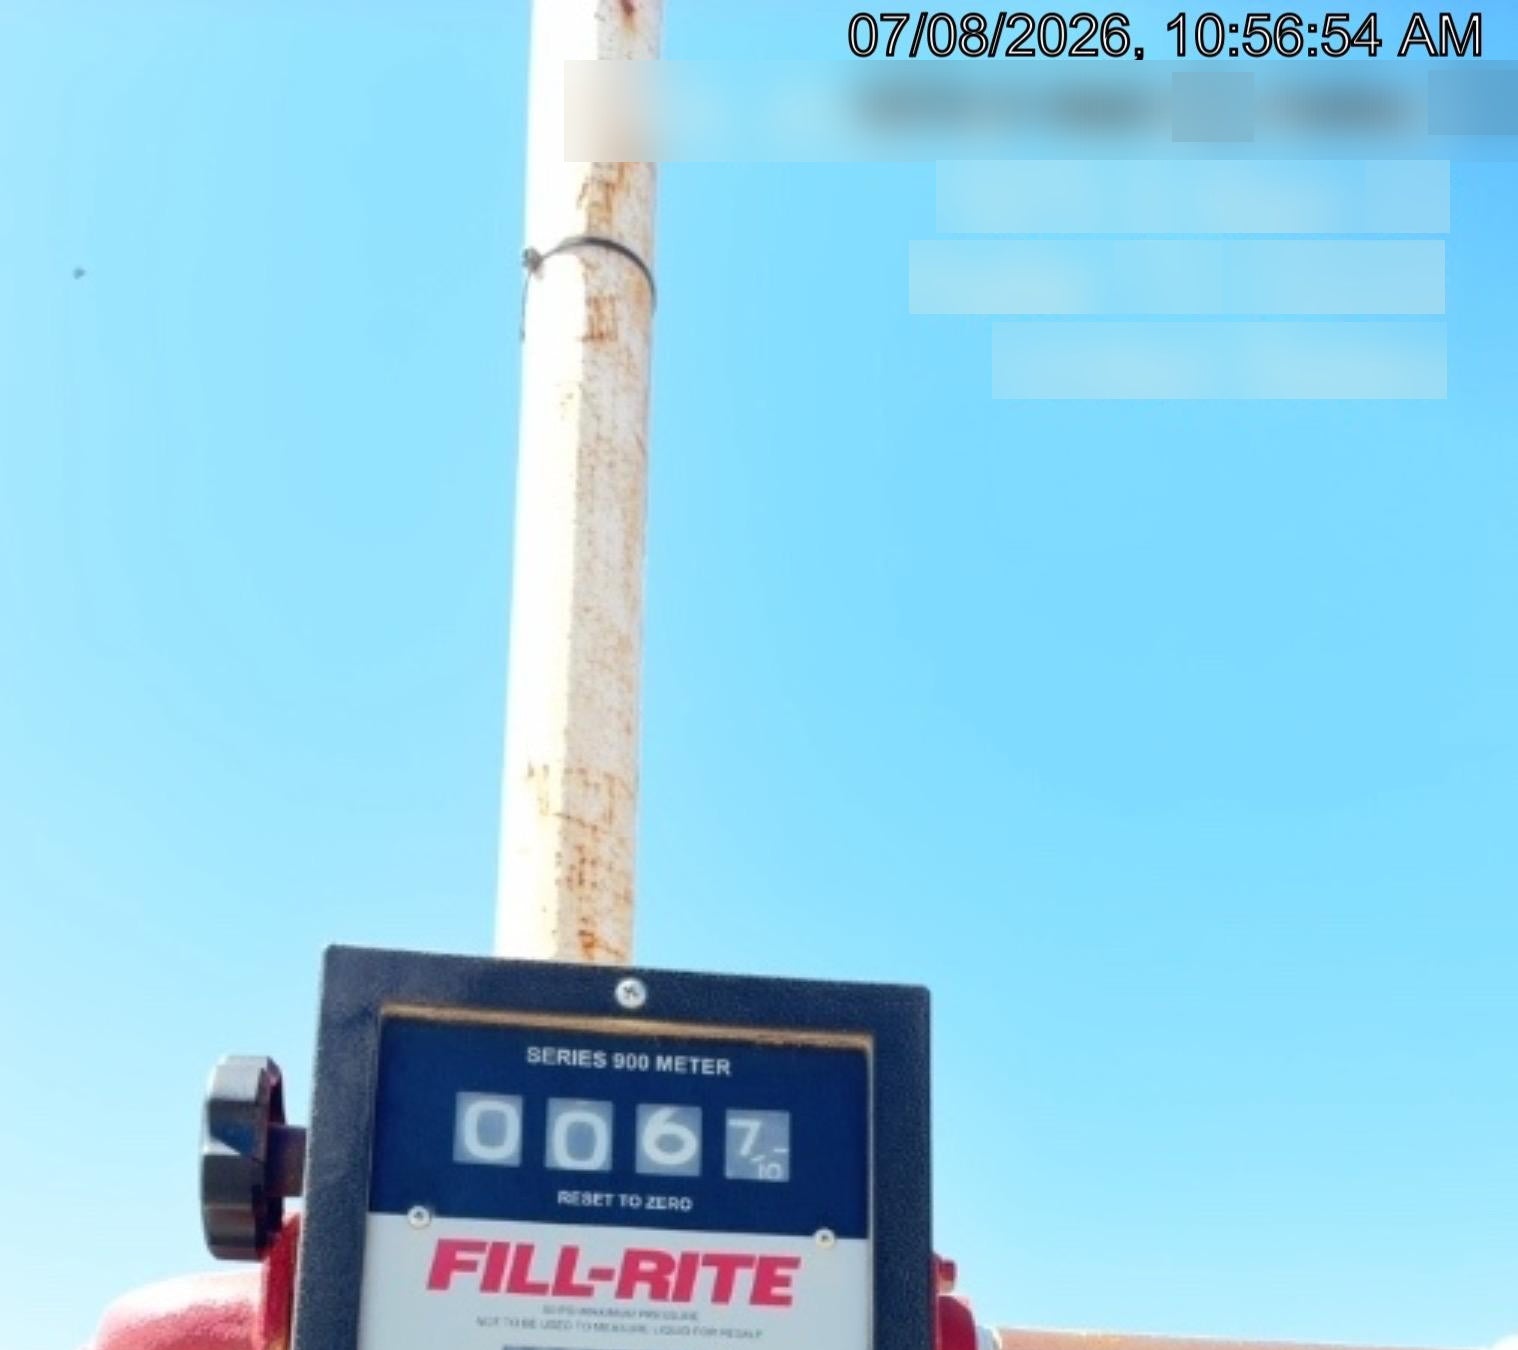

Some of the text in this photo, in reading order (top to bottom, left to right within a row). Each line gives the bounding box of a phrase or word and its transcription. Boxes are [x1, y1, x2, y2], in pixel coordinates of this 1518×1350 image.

[527, 1046, 732, 1077] SERIES 900 METER
[557, 1190, 694, 1212] RESET TO ZERO
[427, 1238, 802, 1308] FILL-RITE
